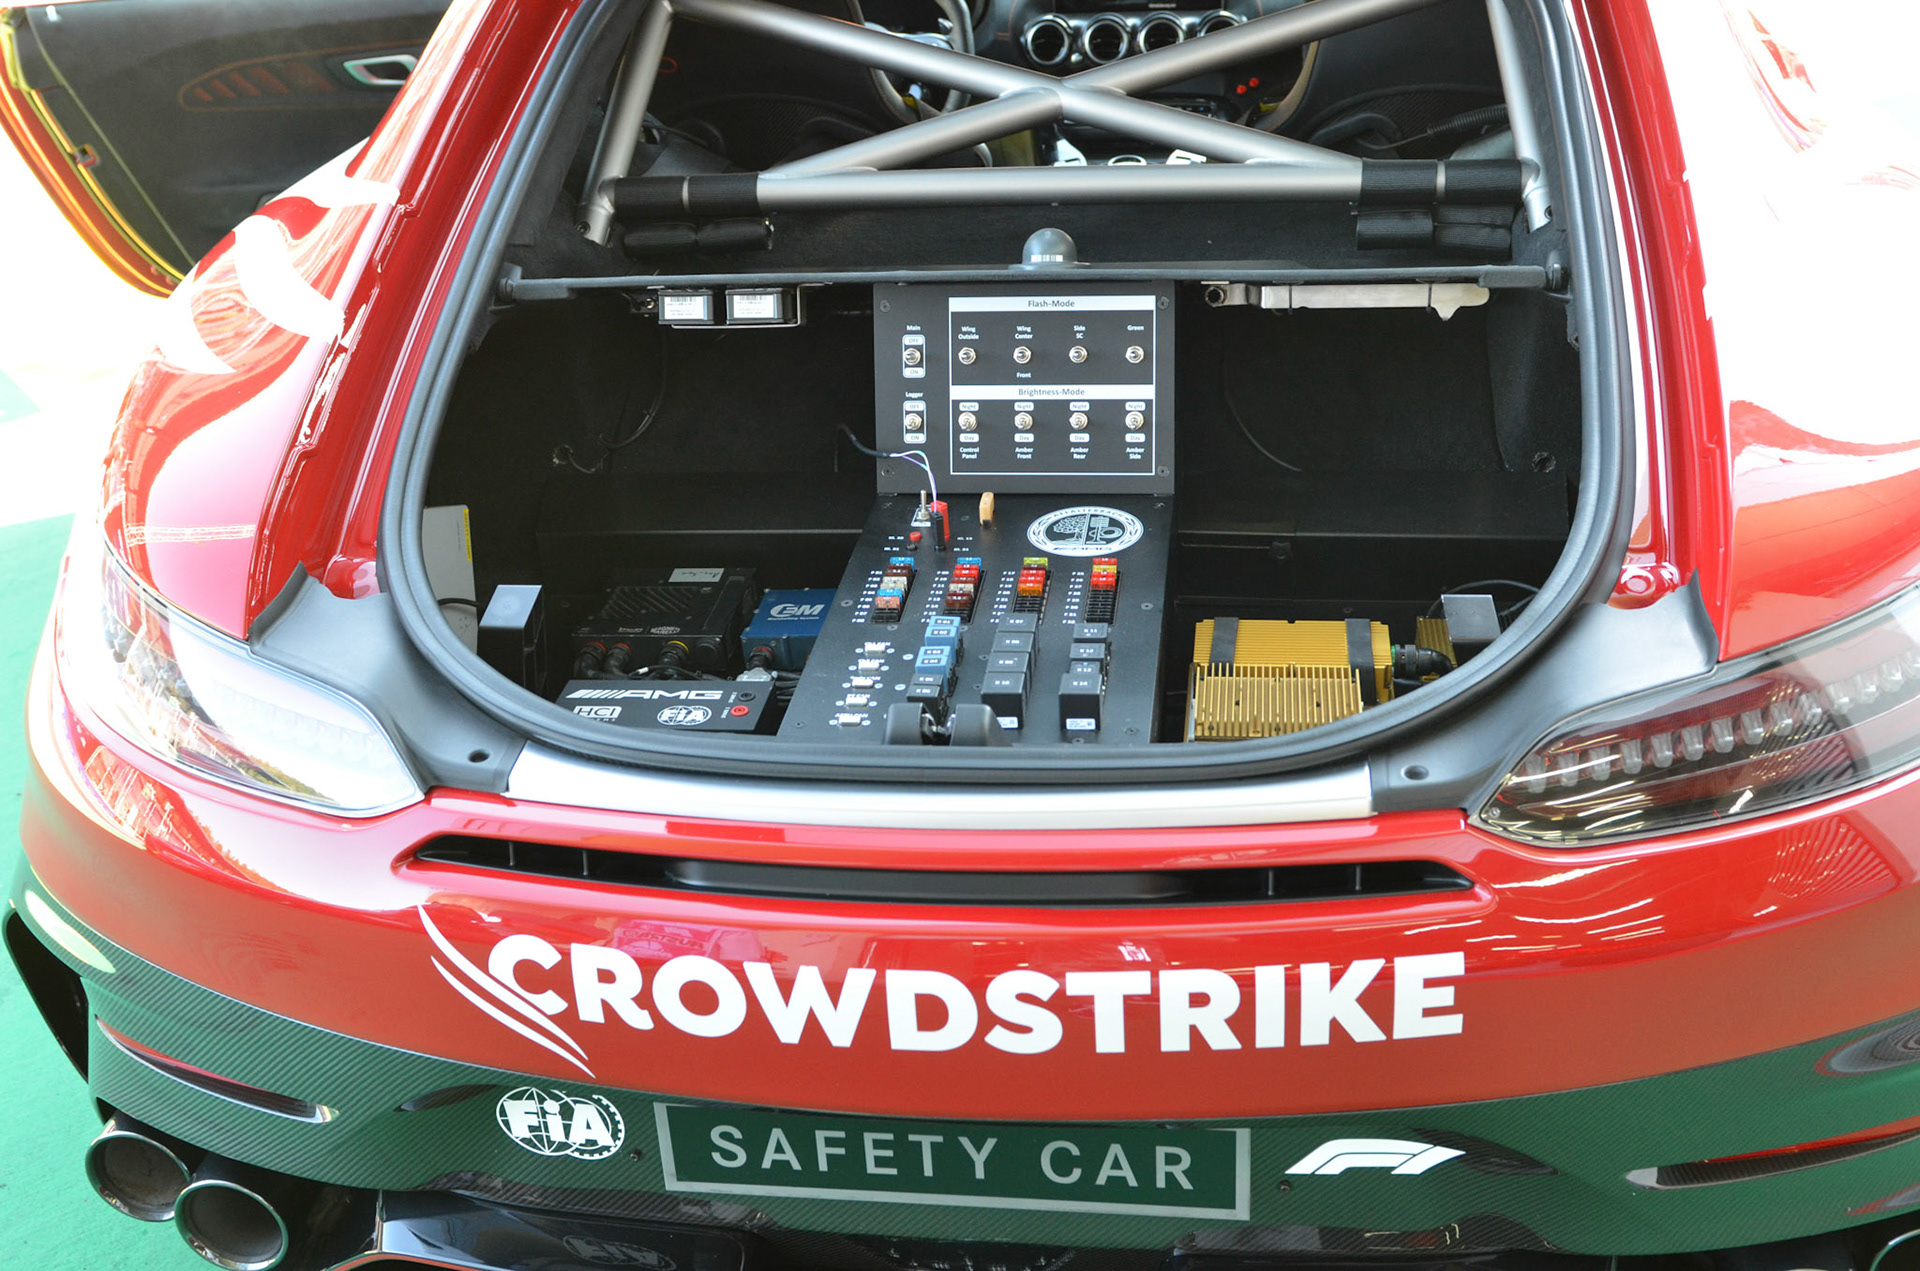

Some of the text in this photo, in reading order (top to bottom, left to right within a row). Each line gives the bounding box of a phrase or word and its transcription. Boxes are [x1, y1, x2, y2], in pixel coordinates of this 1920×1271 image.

[1028, 299, 1075, 308] Flash-Mode
[905, 391, 923, 399] Logger
[1018, 388, 1085, 397] Brightness-Mode
[488, 935, 1465, 1054] CROWDSTRIKE
[710, 1123, 1194, 1191] SAFETY CAR
